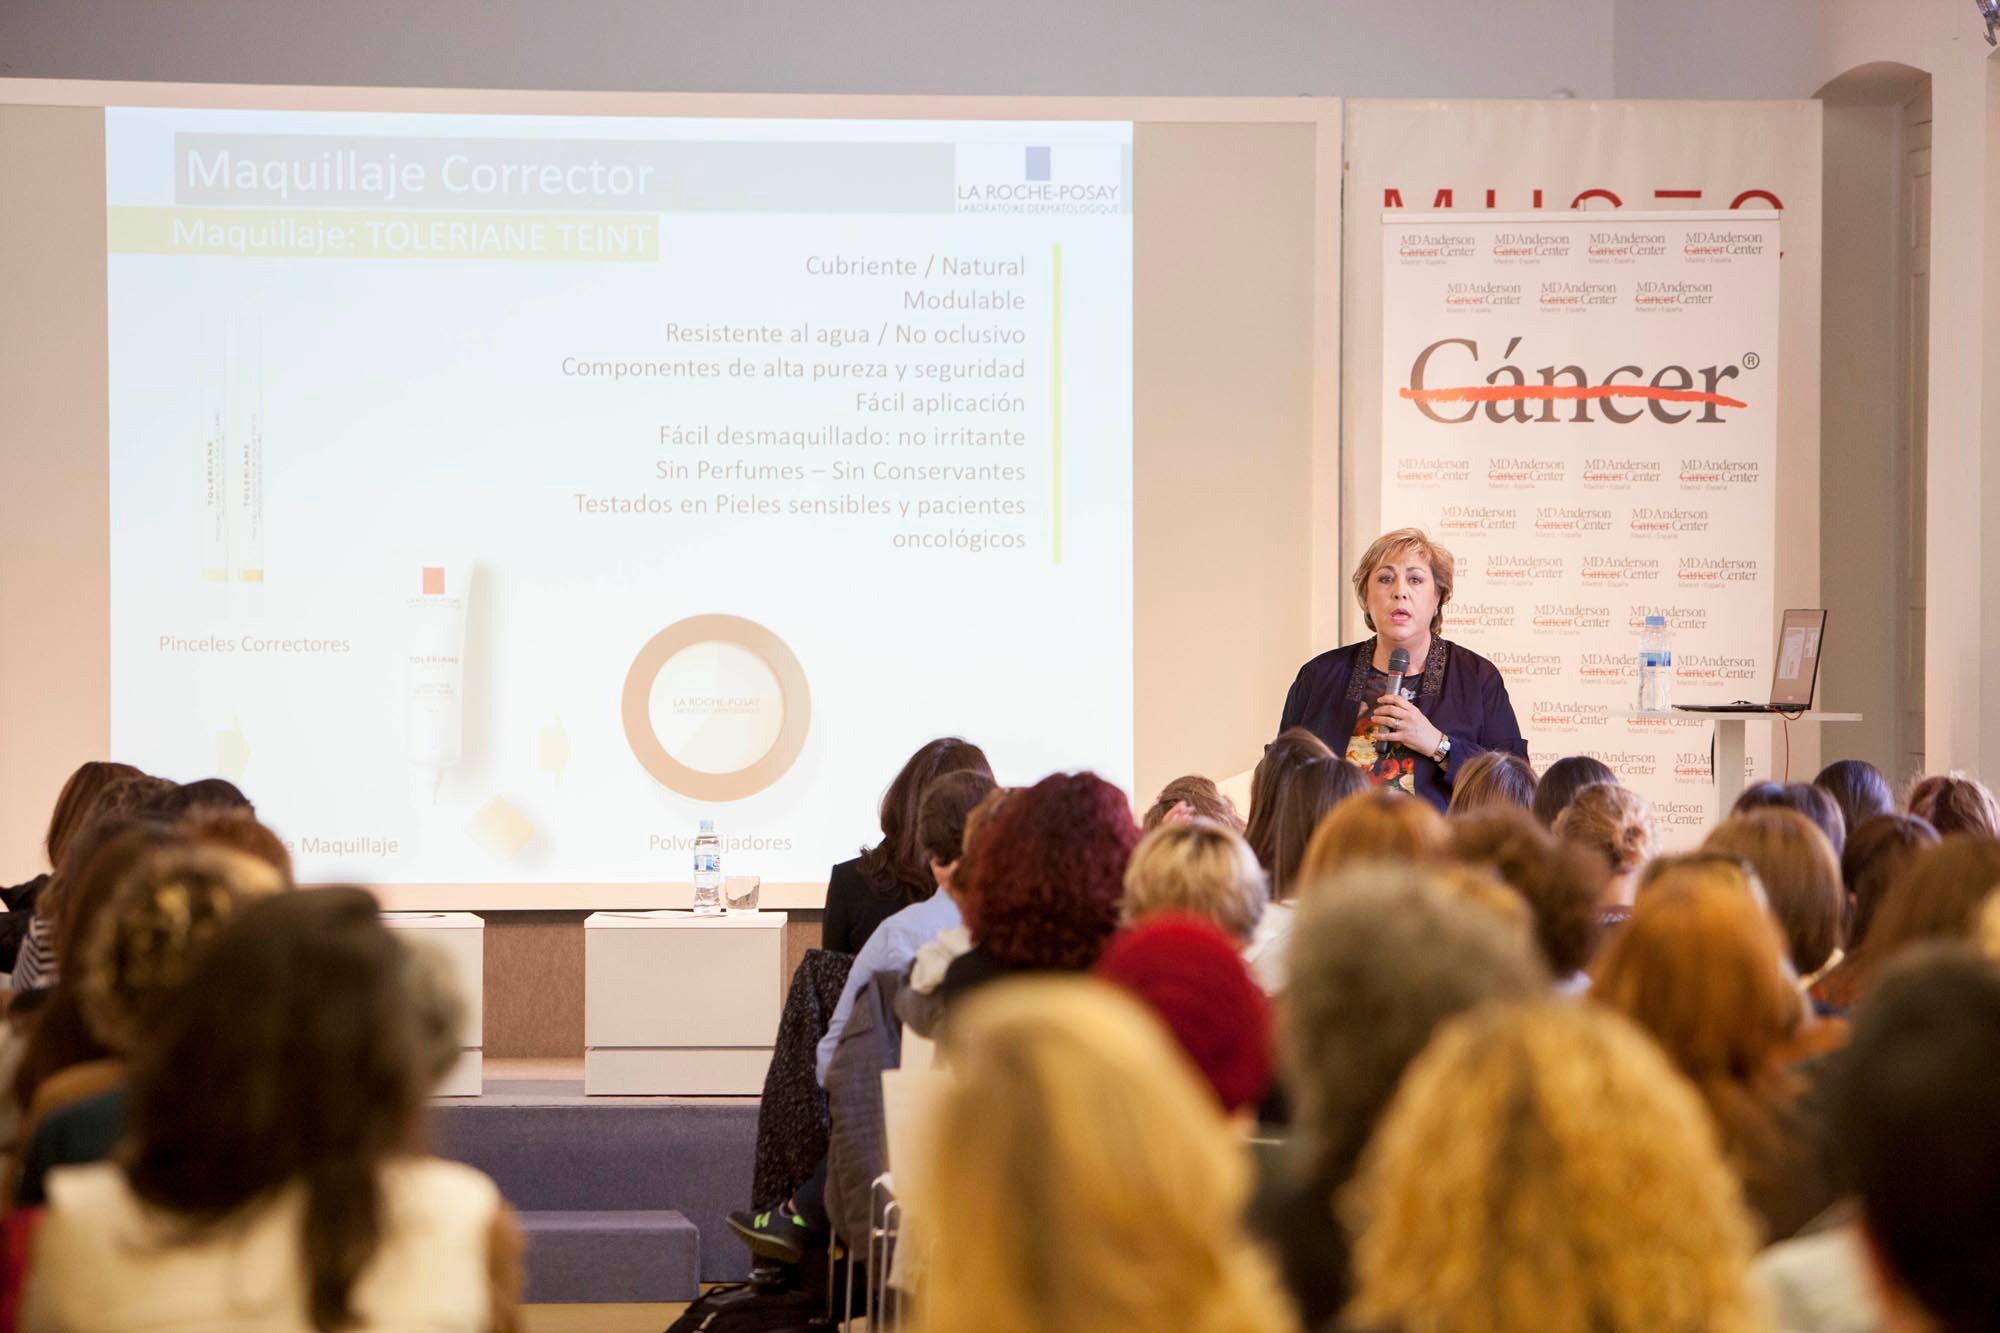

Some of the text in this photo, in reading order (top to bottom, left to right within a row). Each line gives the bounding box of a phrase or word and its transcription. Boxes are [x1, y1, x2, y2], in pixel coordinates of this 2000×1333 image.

[187, 149, 654, 199] Maquillaje Corrector
[958, 184, 1118, 200] LA ROCHE-POSAY
[173, 217, 651, 252] Maquillaje: TOLERIANE TEINT
[1439, 245, 1475, 255] Center
[1534, 245, 1570, 255] Center
[1629, 244, 1666, 254] Center
[1726, 243, 1763, 254] Center
[806, 255, 917, 276] Cubriente
[943, 256, 1024, 276] Natural
[904, 290, 1025, 310] Modulable
[1486, 294, 1521, 304] Center
[1580, 293, 1616, 304] Center
[1676, 293, 1713, 303] Center
[666, 323, 782, 343] Resistente
[790, 323, 809, 343] al
[816, 328, 870, 348] agua
[896, 325, 926, 344] No
[934, 324, 1025, 344] oclusivo
[562, 357, 1024, 383] Componentes de alta pureza y seguridad
[856, 391, 1024, 417] Fácil aplicación
[660, 425, 1025, 451] Fácil desmaquillado: no irritante
[656, 461, 688, 480] Sin
[697, 460, 804, 480] Perfumes
[832, 462, 864, 481] Sin
[873, 462, 1025, 481] Conservantes
[1529, 469, 1565, 480] Center
[1624, 470, 1661, 481] Center
[1721, 471, 1758, 482] Center
[574, 494, 1025, 519] Testados en Pieles sensibles y pacientes
[1480, 518, 1516, 528] Center
[1575, 519, 1612, 529] Center
[1672, 519, 1708, 530] Center
[892, 529, 1025, 551] oncológicos
[1527, 566, 1563, 577] Center
[1622, 568, 1659, 578] Center
[1719, 569, 1757, 580] Center
[1574, 616, 1610, 626] Center
[159, 634, 350, 653] Pinceles Correctores
[1718, 667, 1755, 678] Center
[302, 837, 399, 856] Maquillaje
[650, 834, 792, 853] Polvo ijadores
